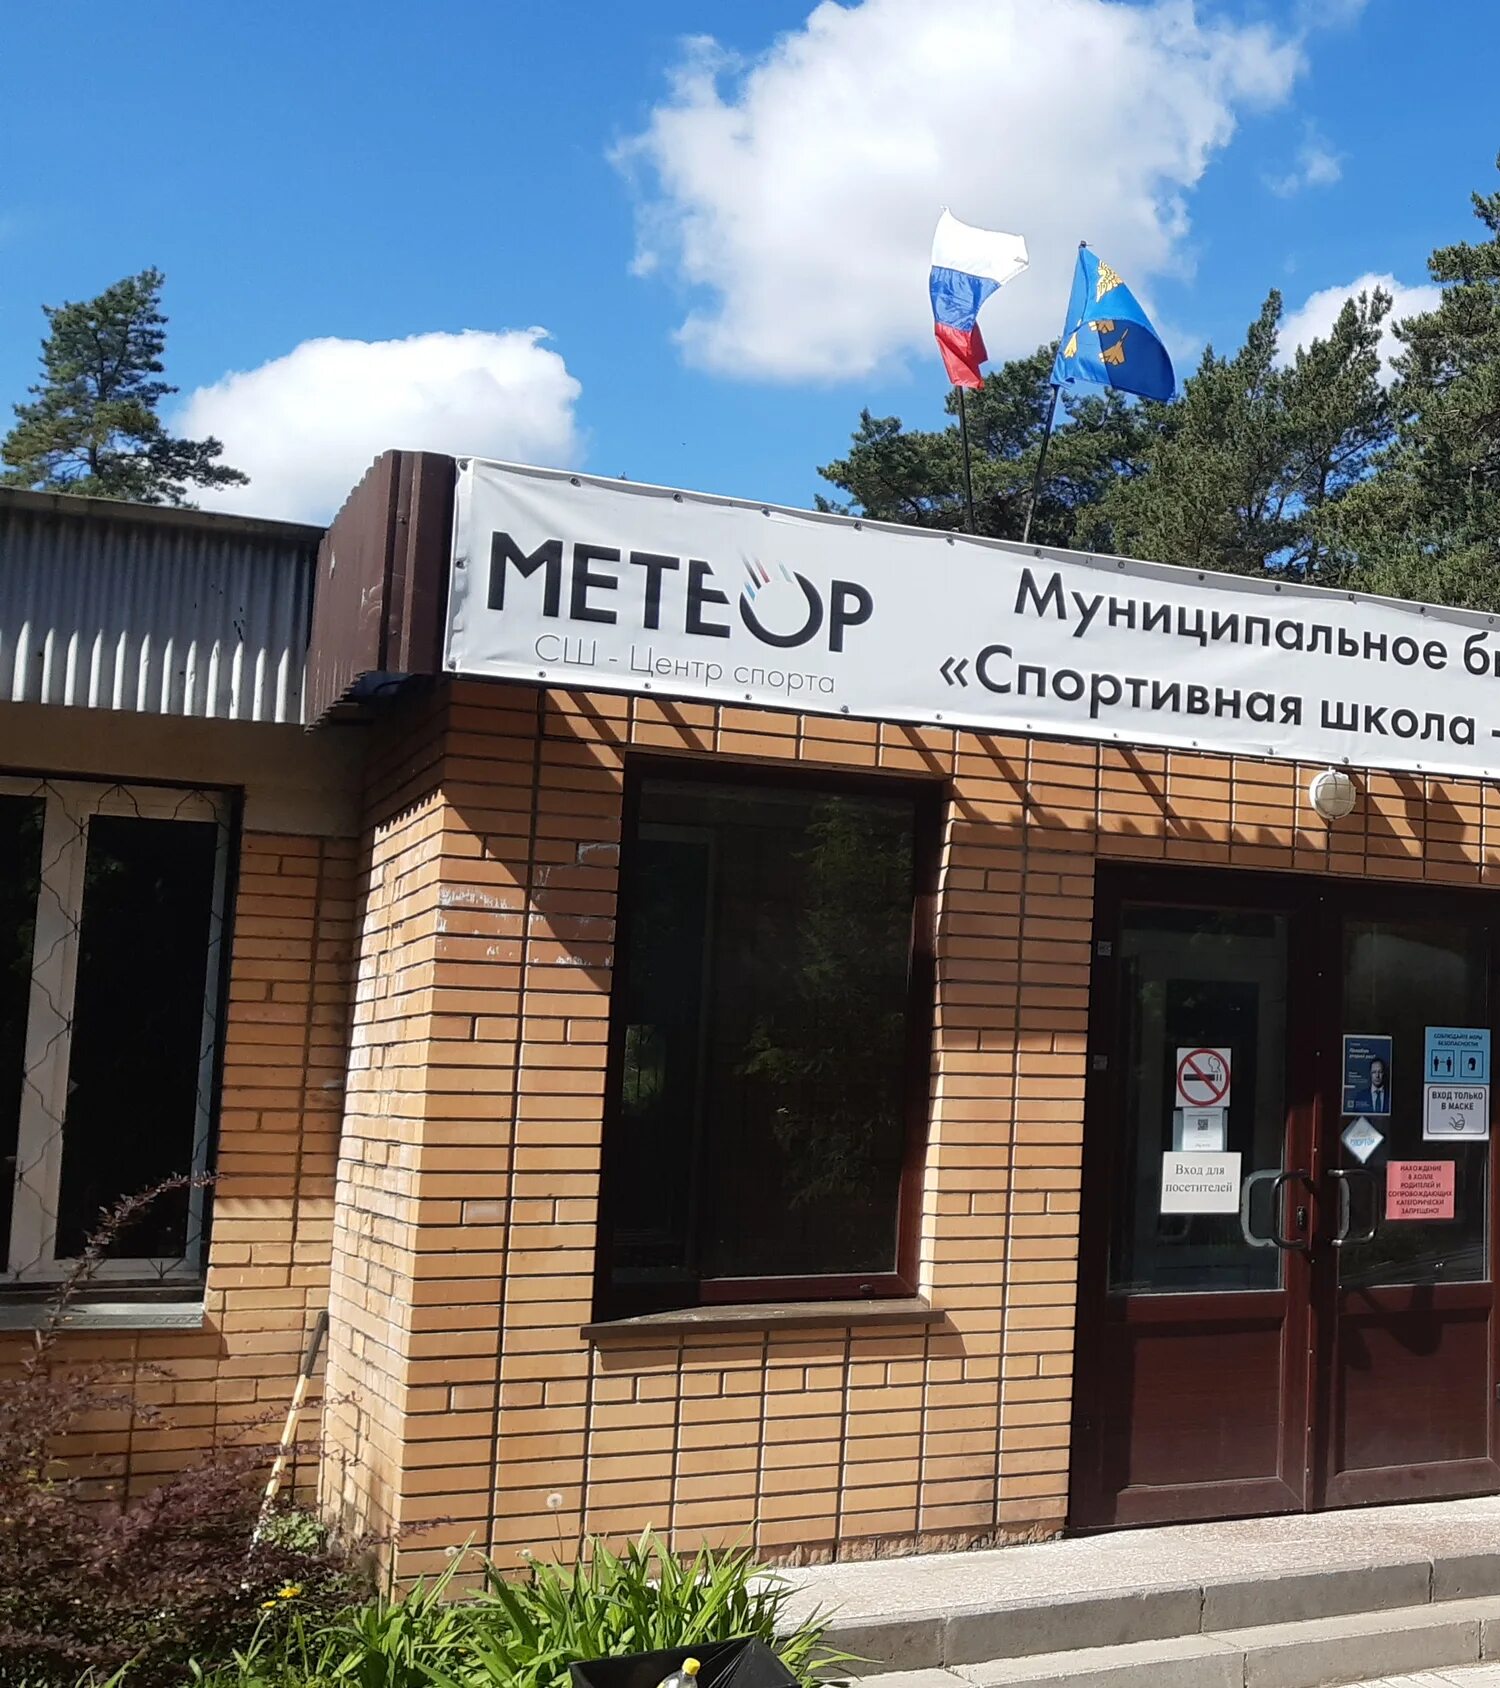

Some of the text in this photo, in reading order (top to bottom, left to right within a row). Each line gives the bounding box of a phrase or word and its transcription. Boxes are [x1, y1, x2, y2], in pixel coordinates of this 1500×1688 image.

[486, 530, 874, 653] МЕТЕОР
[1014, 568, 1448, 671] Муниципальное
[535, 633, 597, 667] СШ
[627, 644, 724, 688] Центр
[733, 663, 836, 695] спорта
[940, 643, 1302, 724] «Спортивная
[1321, 699, 1475, 745] школа
[1432, 1091, 1483, 1100] ВХОД ТОЛЬКО
[1441, 1102, 1474, 1111] В МАСКЕ
[1175, 1163, 1225, 1176] Вход для
[1165, 1181, 1233, 1193] посетителей
[1400, 1180, 1435, 1188] РОДИТЕЛЕЙ
